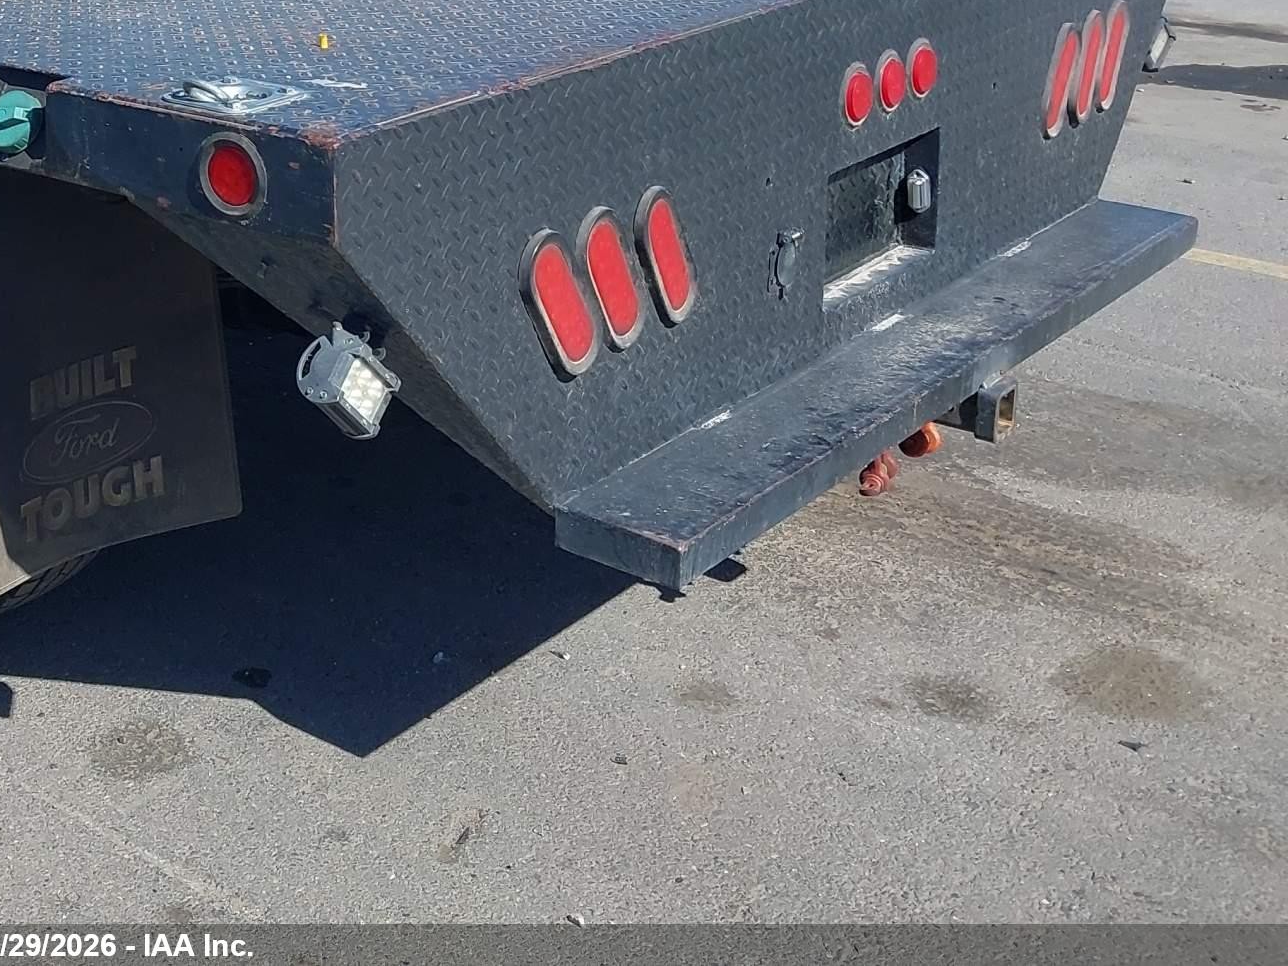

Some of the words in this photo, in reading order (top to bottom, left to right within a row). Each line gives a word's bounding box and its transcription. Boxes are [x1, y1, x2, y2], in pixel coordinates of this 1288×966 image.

[29, 345, 137, 421] BUILT
[48, 413, 121, 467] Ford
[20, 454, 165, 543] TOUGH
